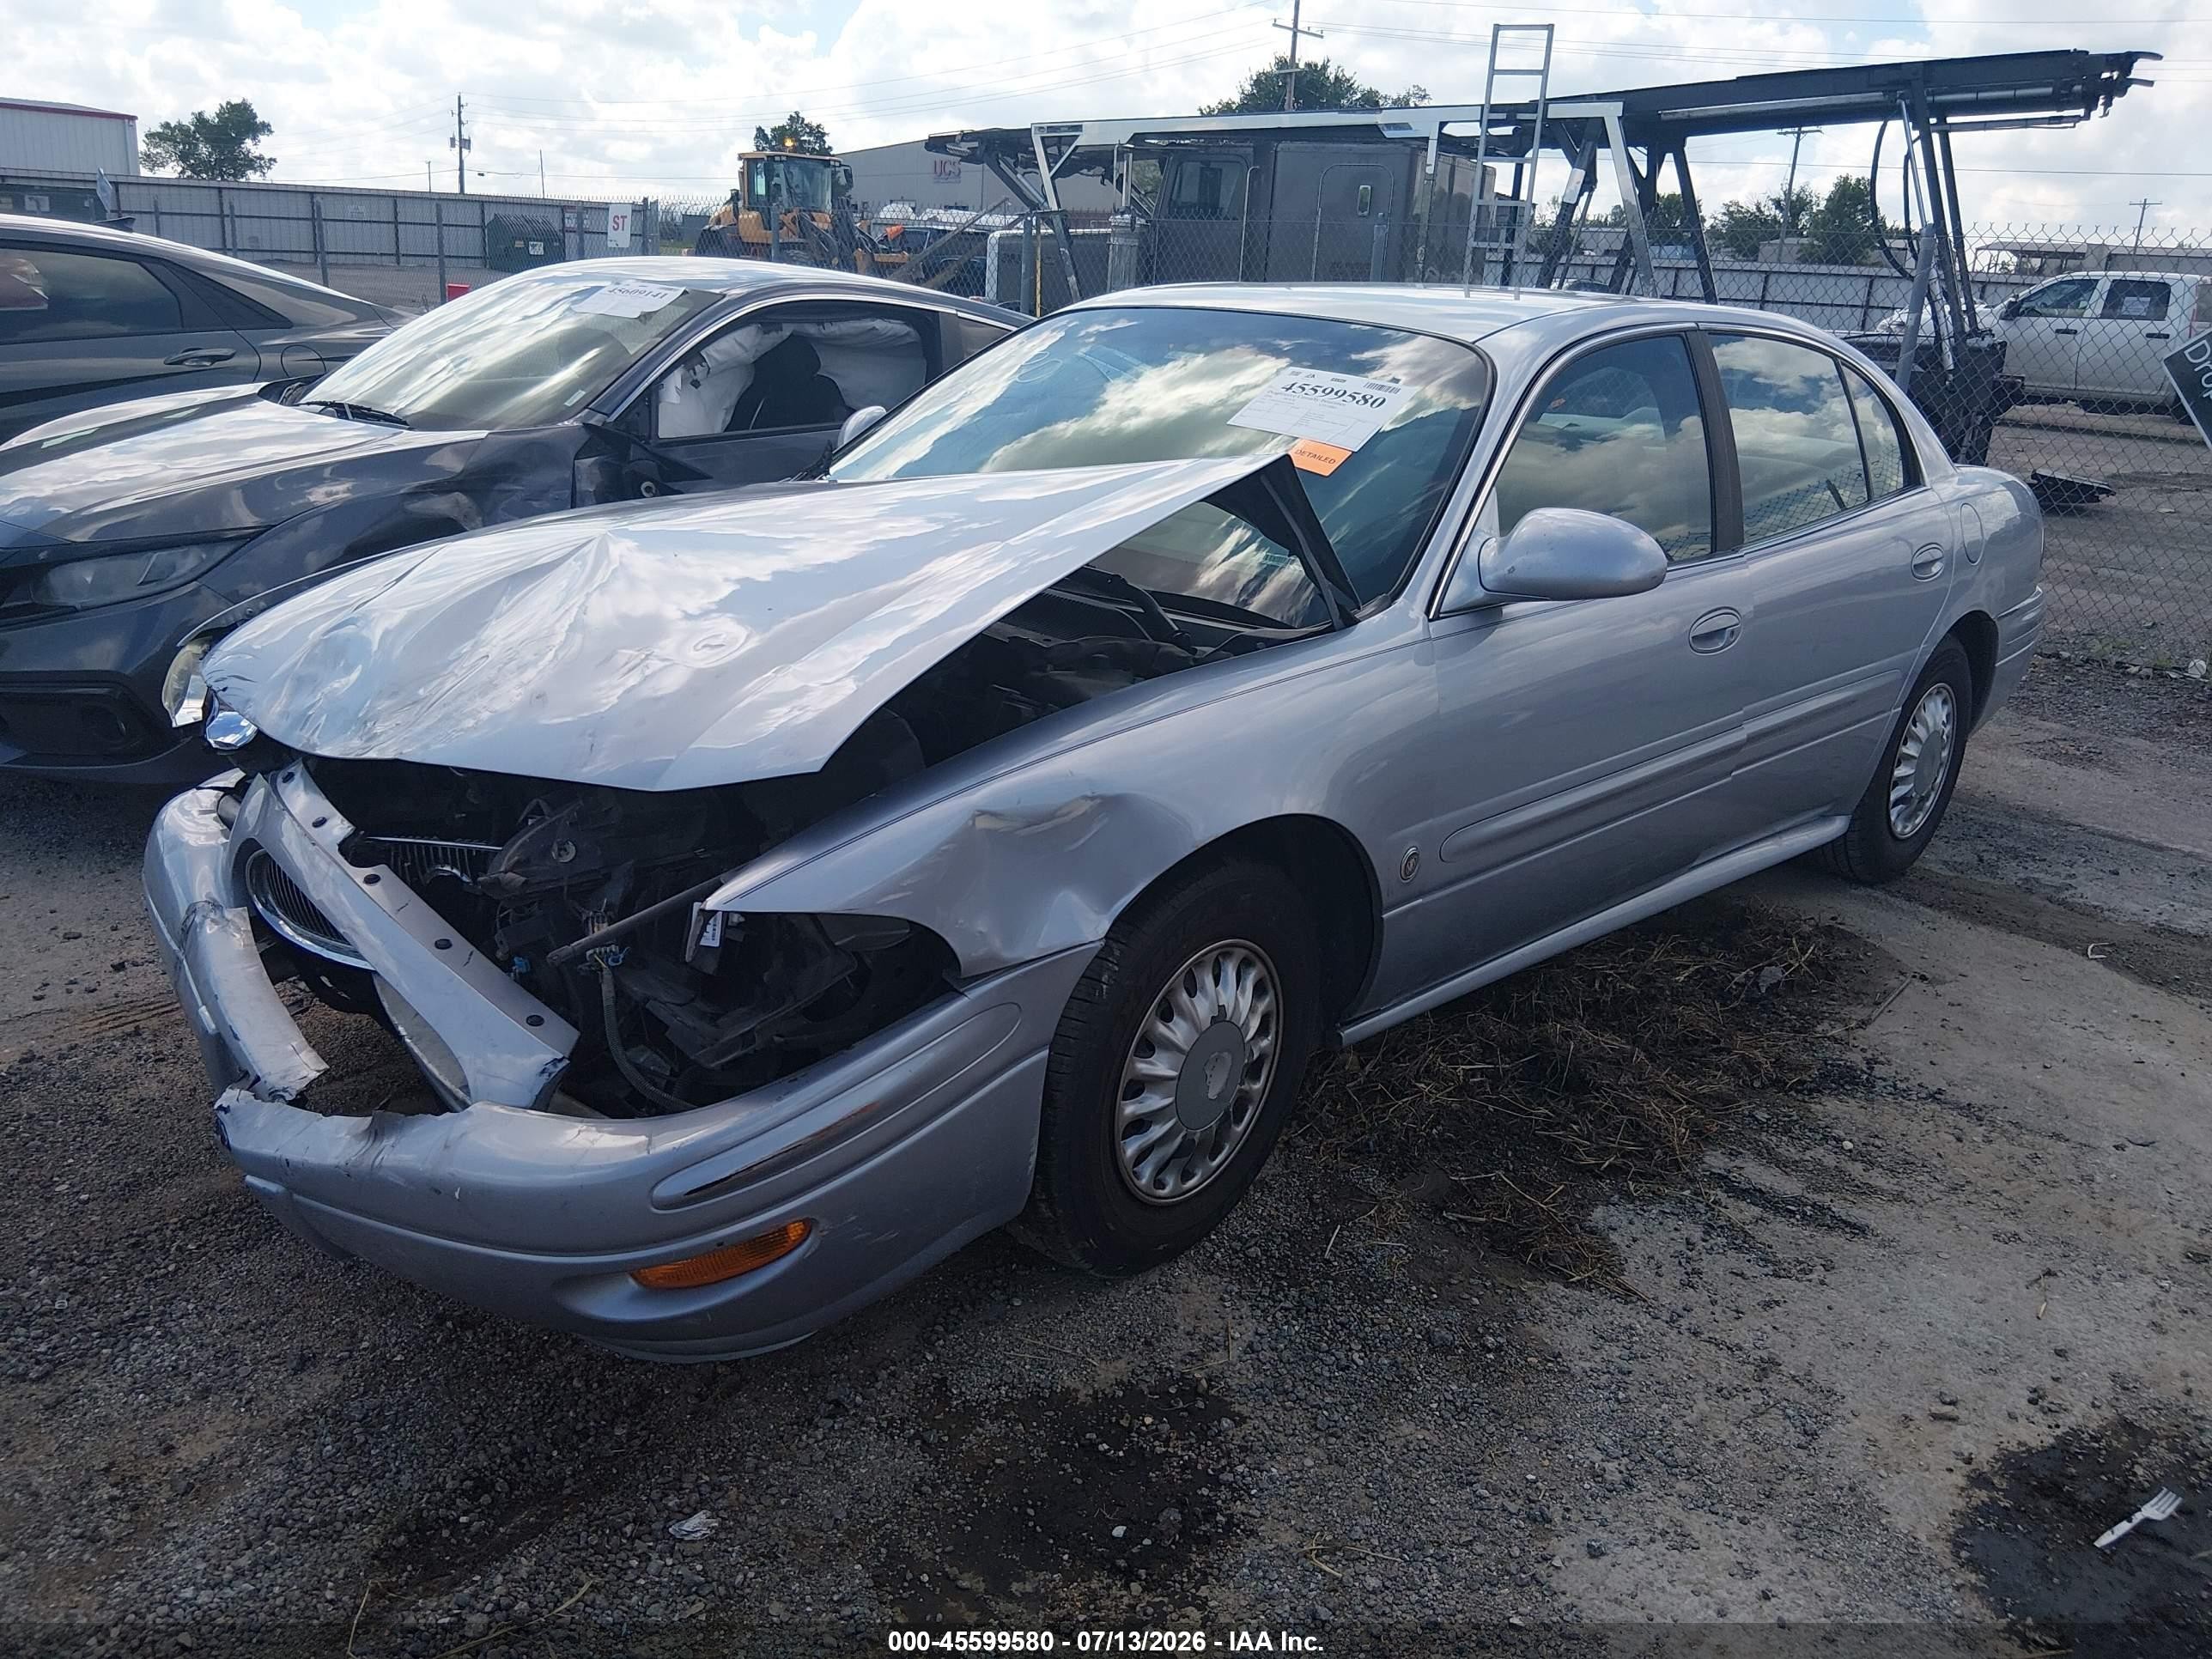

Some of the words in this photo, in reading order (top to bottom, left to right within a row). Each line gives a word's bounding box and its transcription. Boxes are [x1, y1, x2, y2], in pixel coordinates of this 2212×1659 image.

[612, 215, 628, 232] ST
[1280, 381, 1386, 409] 45599580
[1295, 449, 1336, 465] DETAILED
